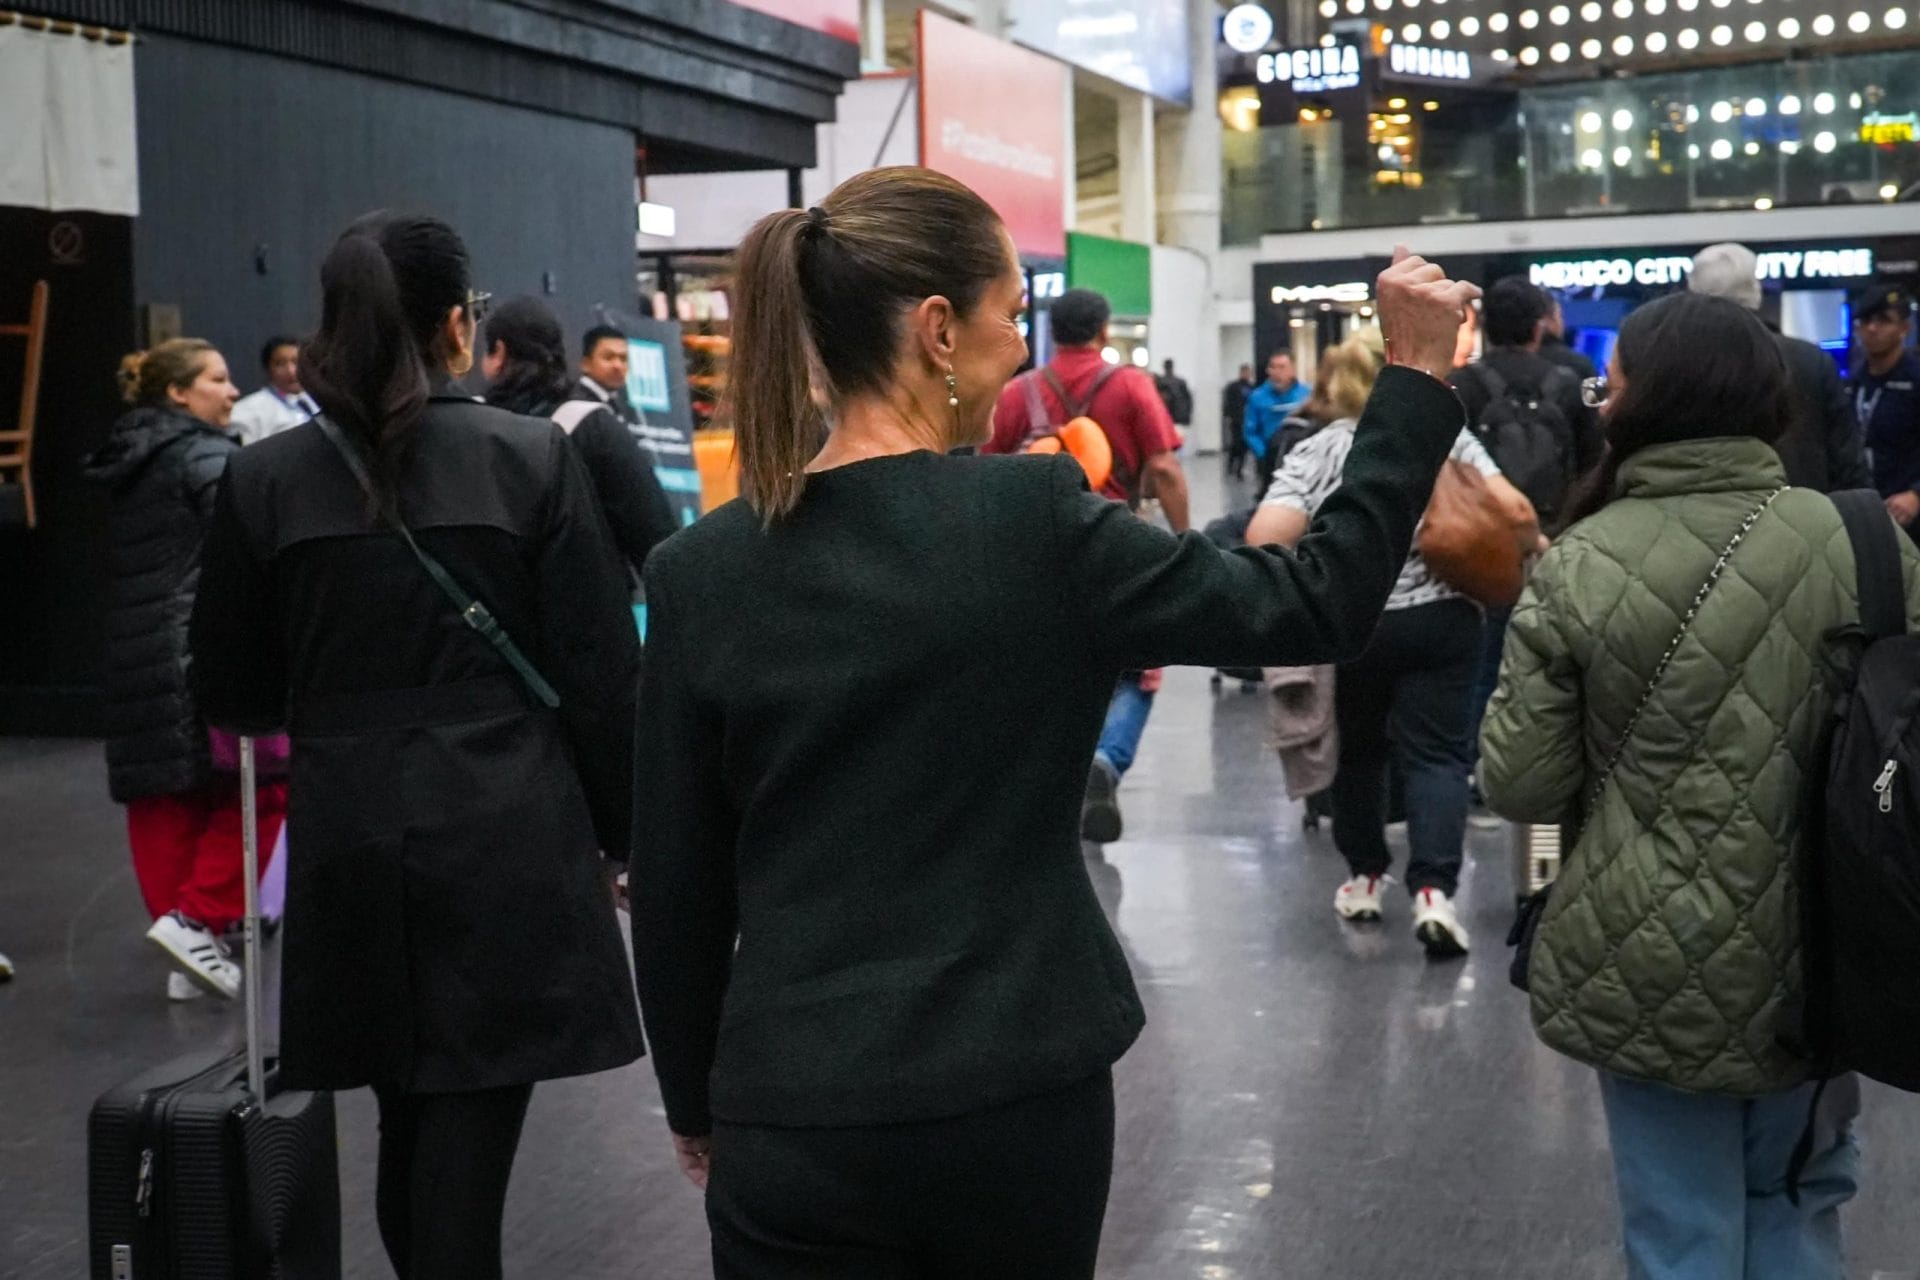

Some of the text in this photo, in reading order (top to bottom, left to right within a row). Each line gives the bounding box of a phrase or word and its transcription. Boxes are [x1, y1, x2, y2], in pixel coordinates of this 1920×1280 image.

[1530, 258, 1633, 287] MEXICO
[1755, 252, 1802, 279] UTY
[1804, 249, 1874, 277] FREE
